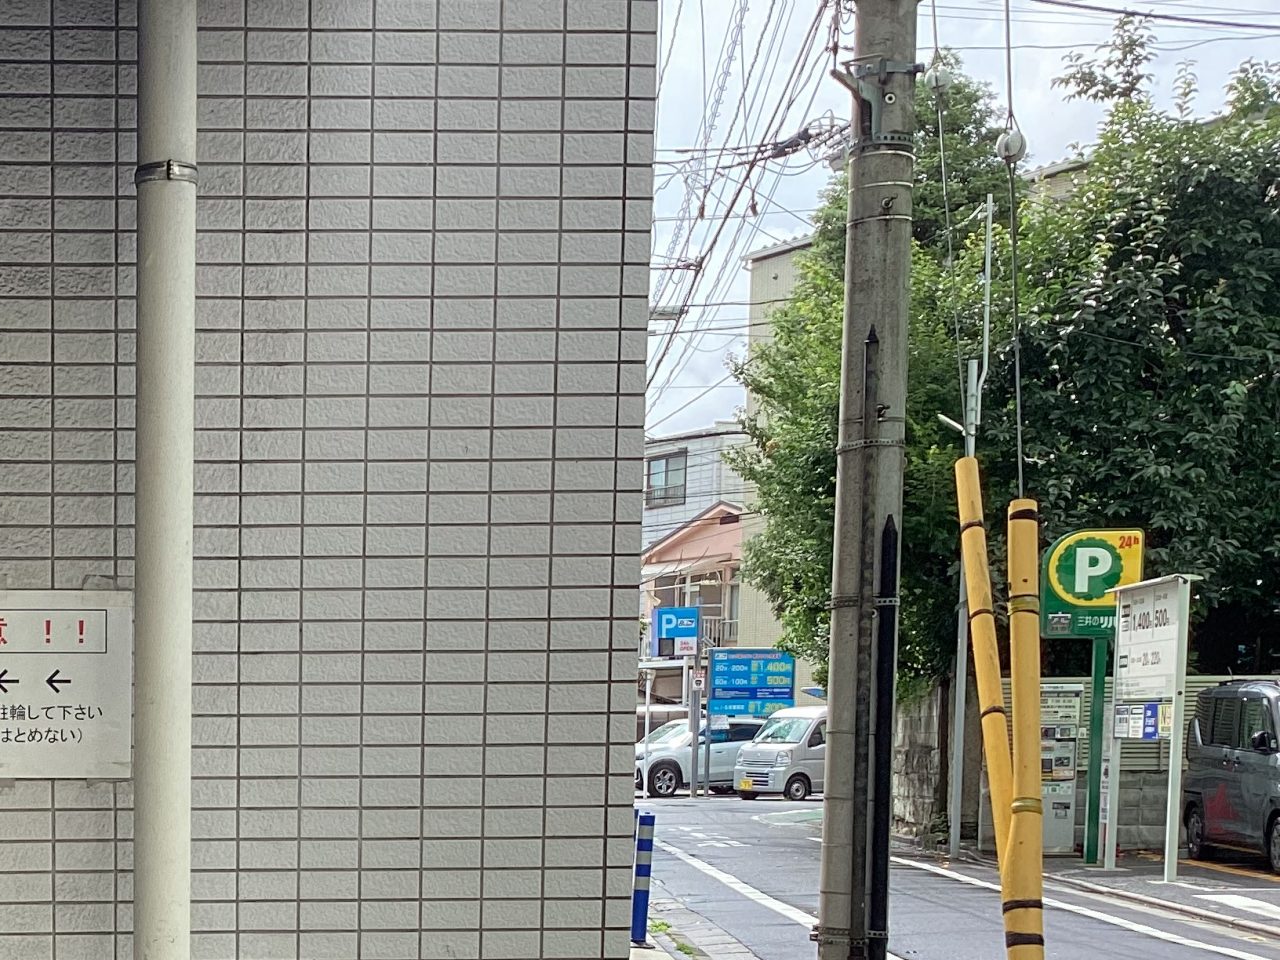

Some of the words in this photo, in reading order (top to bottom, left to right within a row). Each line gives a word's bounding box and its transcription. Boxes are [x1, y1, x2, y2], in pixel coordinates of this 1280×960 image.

[1119, 535, 1140, 549] 24h
[1074, 547, 1113, 593] P
[662, 614, 677, 639] P
